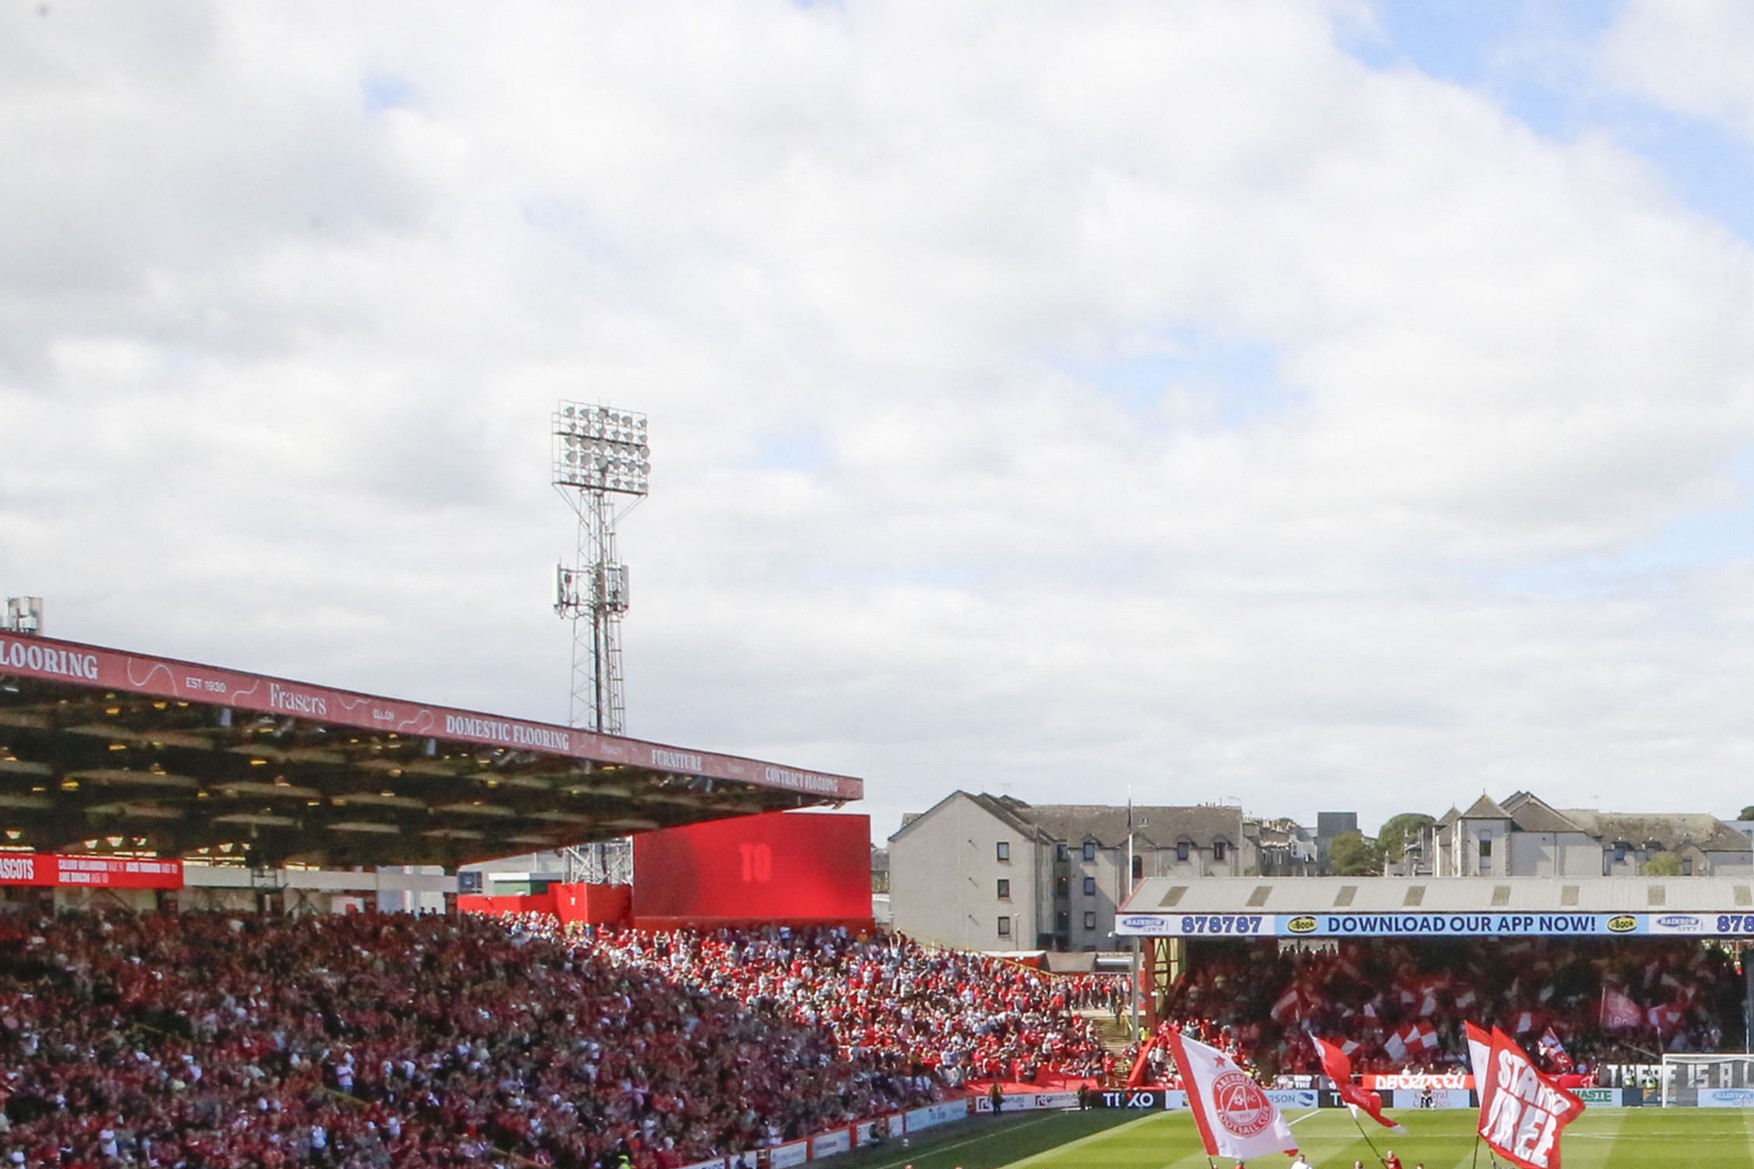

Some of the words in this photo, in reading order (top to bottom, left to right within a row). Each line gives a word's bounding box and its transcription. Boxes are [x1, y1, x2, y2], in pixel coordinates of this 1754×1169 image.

[0, 639, 98, 679] LOORING
[186, 676, 202, 689] EST
[205, 680, 226, 693] 1930
[269, 683, 327, 716] Frasers
[446, 714, 509, 742] DOMESTIC
[513, 725, 569, 751] FLOORING
[652, 749, 704, 771] FURNITURE
[0, 858, 34, 880] ASCOTS
[1181, 916, 1263, 933] 878787
[1328, 917, 1446, 932] DOWNLOAD
[1450, 916, 1492, 932] OUR
[1497, 916, 1534, 932] APP
[1539, 916, 1596, 932] NOW!
[1719, 1064, 1734, 1088] A
